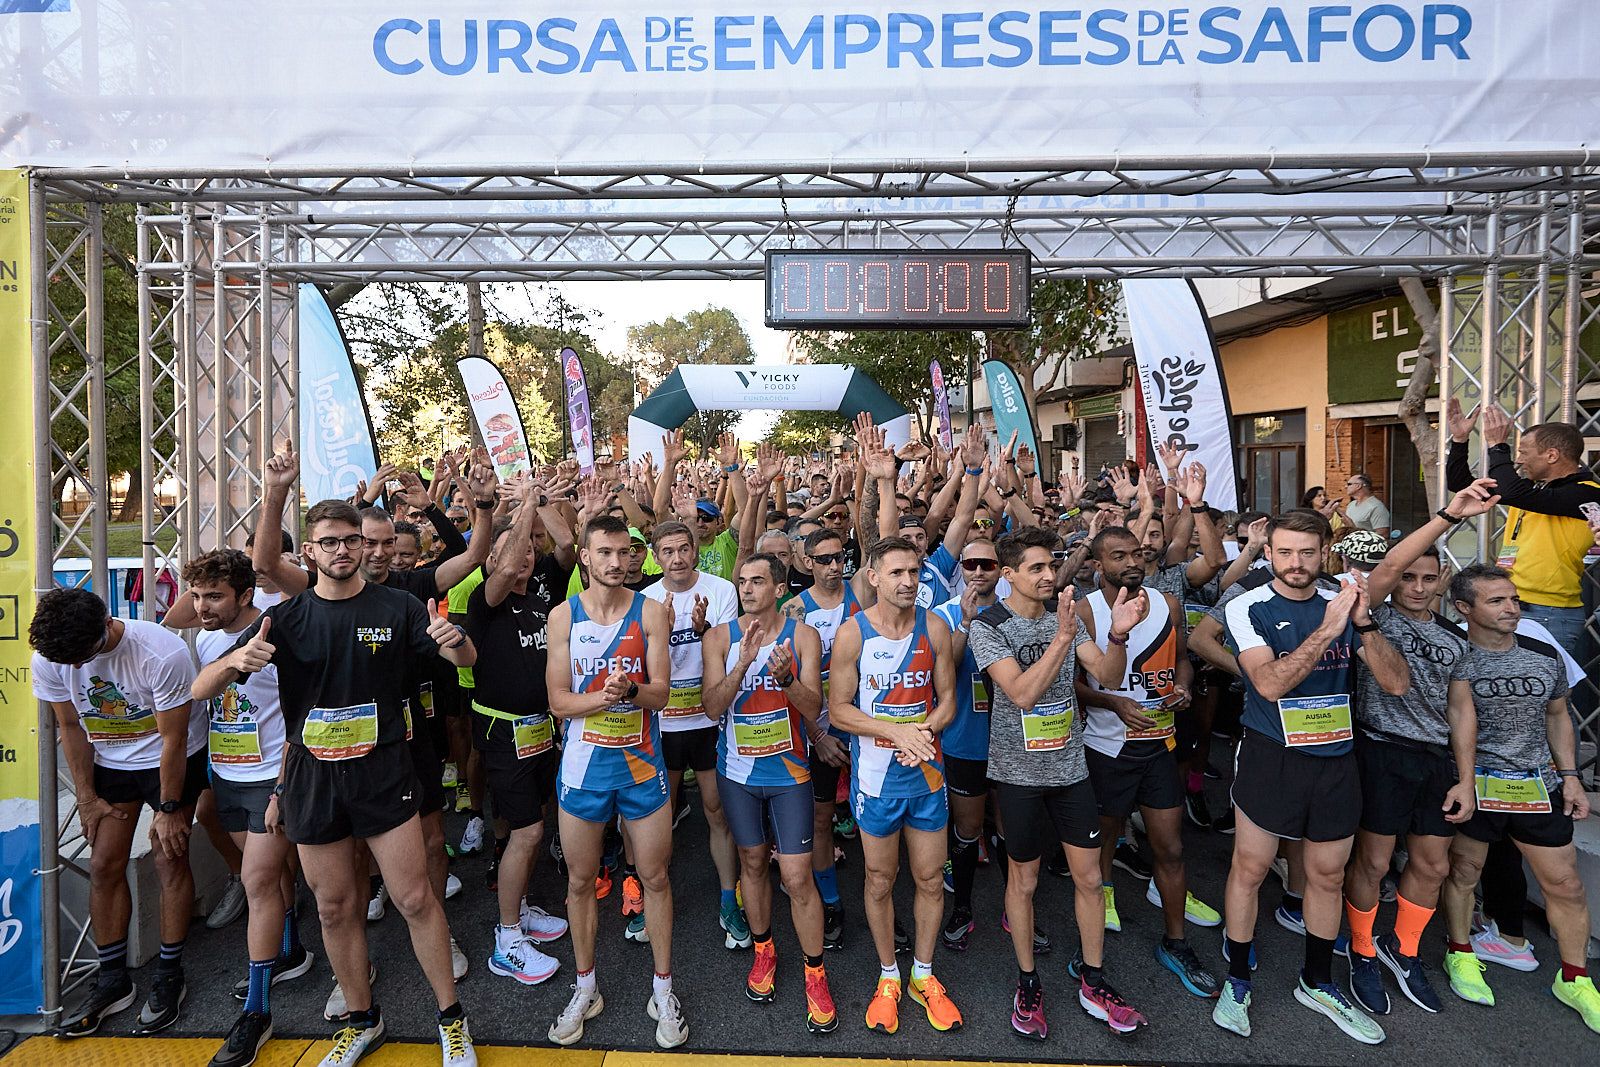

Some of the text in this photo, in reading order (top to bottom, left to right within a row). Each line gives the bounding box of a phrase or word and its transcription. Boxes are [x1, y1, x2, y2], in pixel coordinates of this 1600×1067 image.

[374, 4, 1472, 75] CURSA DE LES EMPRESES DE LA SAFOR
[1371, 306, 1409, 341] EL
[761, 374, 800, 382] VICKY
[356, 634, 392, 642] TODAS
[573, 656, 643, 677] ALPESA
[865, 669, 932, 691] ALPESA
[604, 716, 627, 724] ANGEL
[1305, 712, 1332, 720] AUSIAS
[1041, 718, 1066, 727] Santiago
[222, 737, 240, 745] Carlos
[505, 951, 527, 972] HOKA
